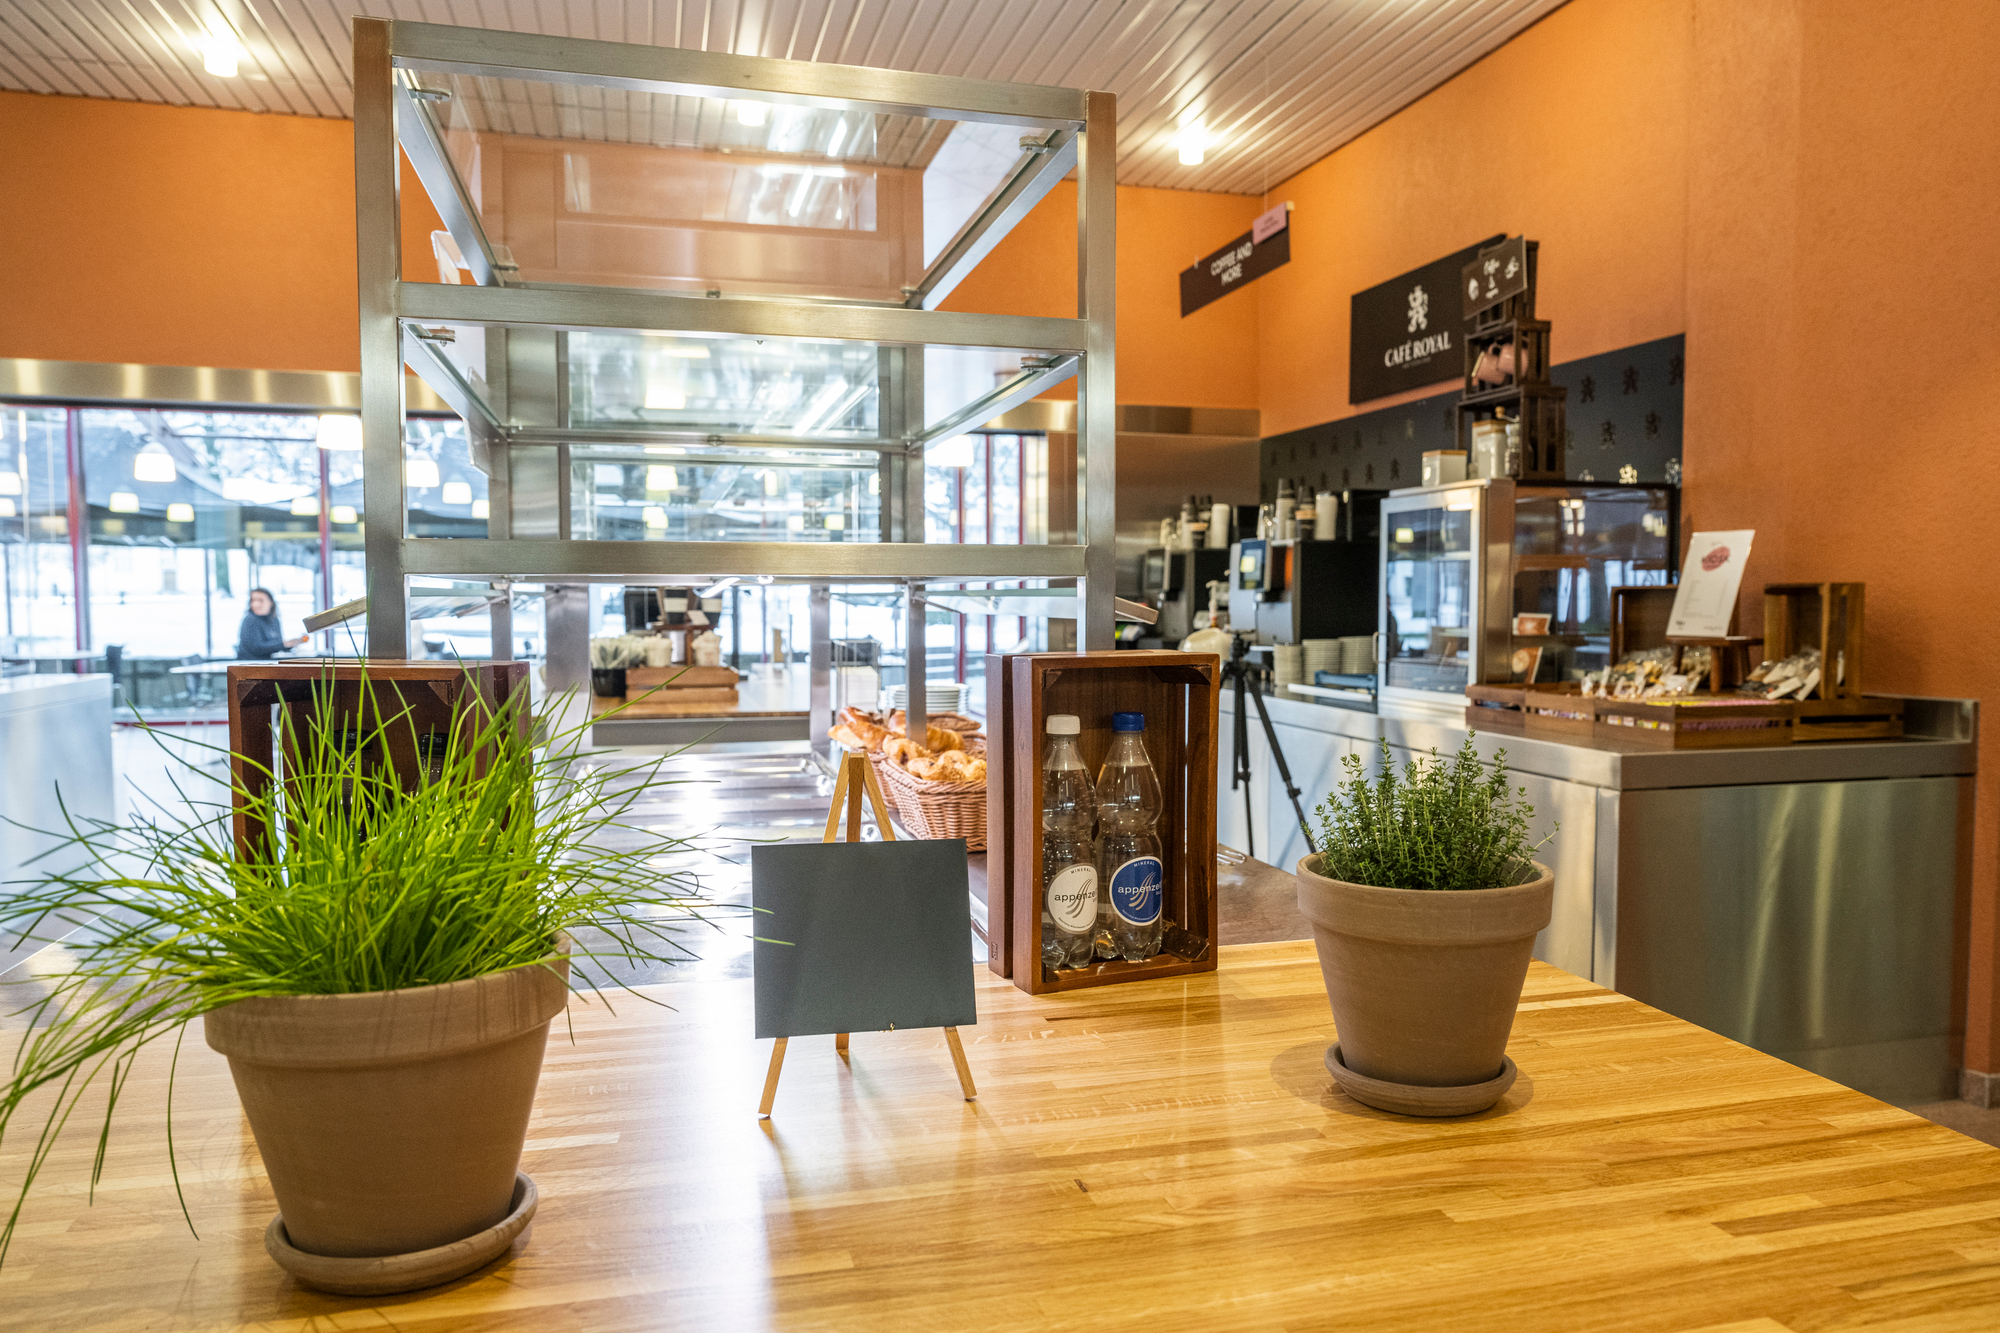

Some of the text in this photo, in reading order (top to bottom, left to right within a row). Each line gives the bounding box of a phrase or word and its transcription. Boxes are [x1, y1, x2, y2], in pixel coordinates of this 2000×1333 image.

[1210, 241, 1253, 277] COFFEE AND
[1221, 263, 1243, 286] MORE
[1384, 339, 1412, 368] CAFÉ
[1412, 331, 1452, 361] ROYAL
